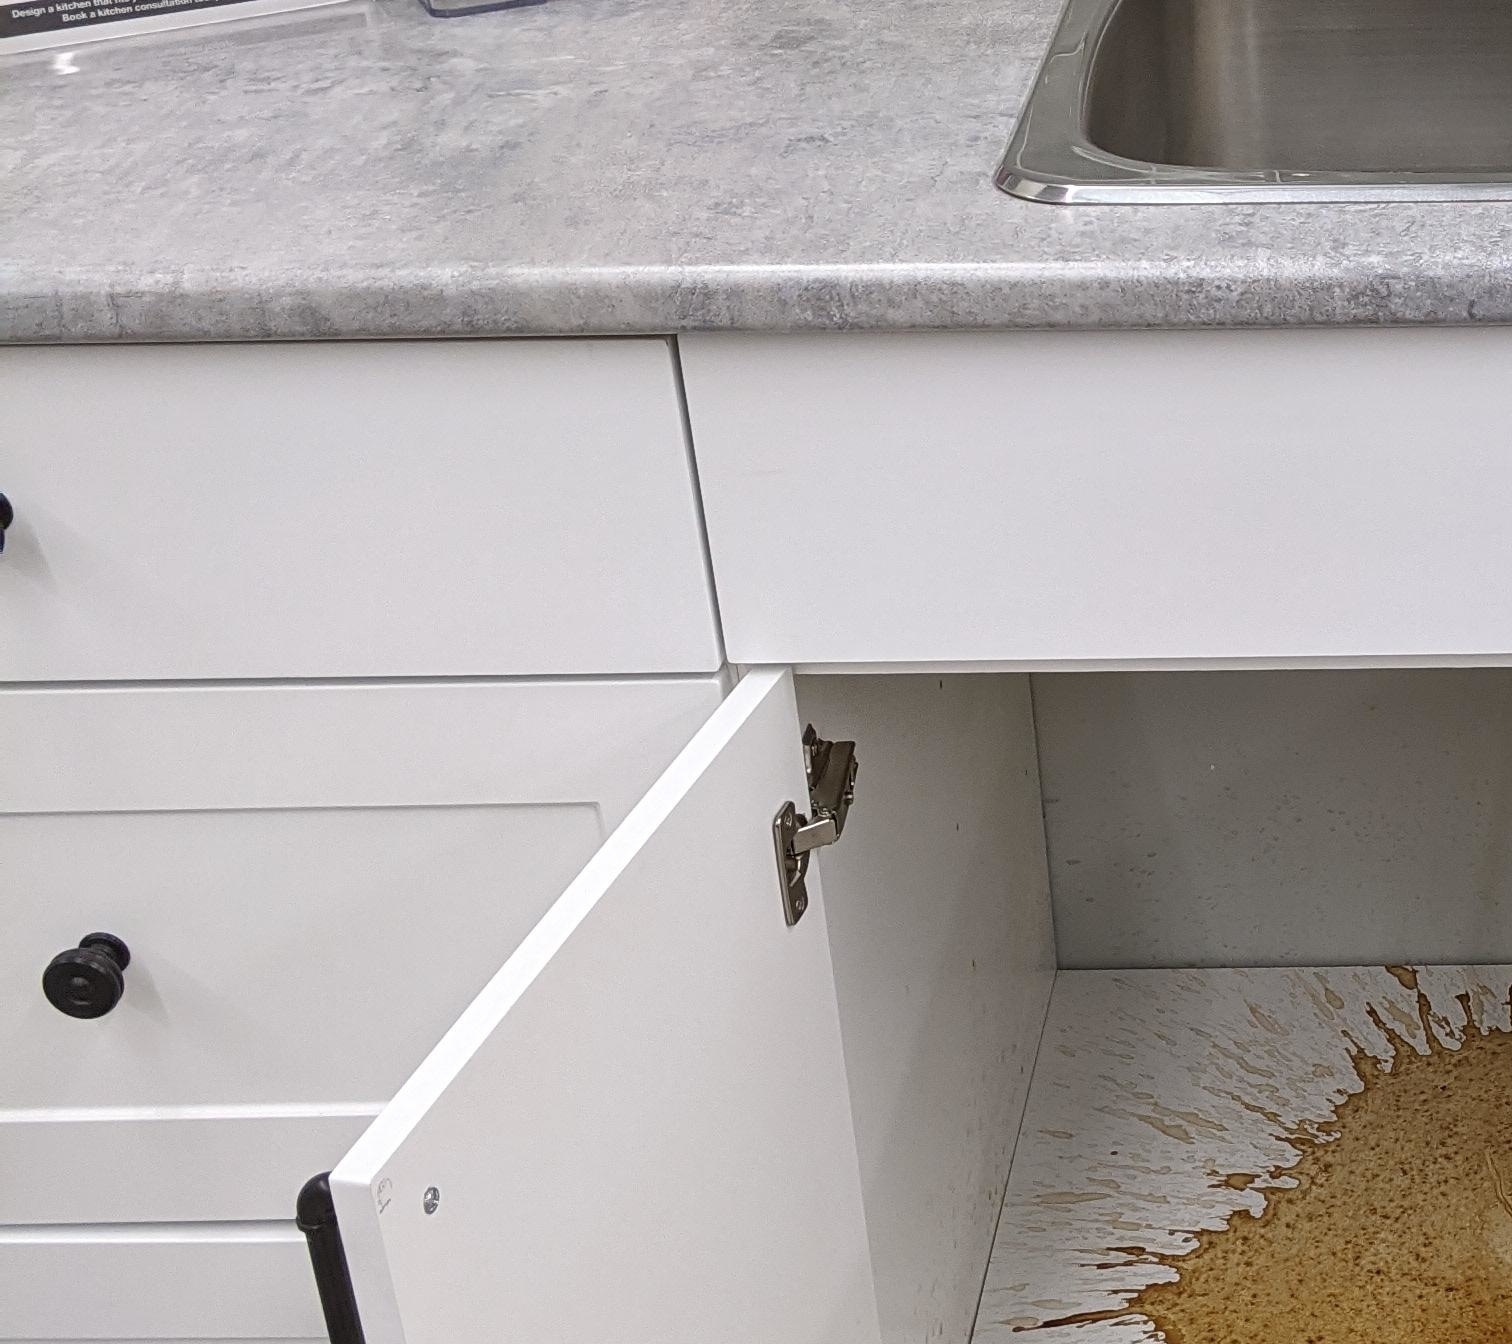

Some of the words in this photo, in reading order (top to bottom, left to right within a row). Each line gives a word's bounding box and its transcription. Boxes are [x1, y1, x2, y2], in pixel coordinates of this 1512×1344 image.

[12, 7, 47, 19] Design
[56, 0, 91, 12] kitchen
[62, 11, 88, 23] Book
[99, 4, 133, 17] kitchen
